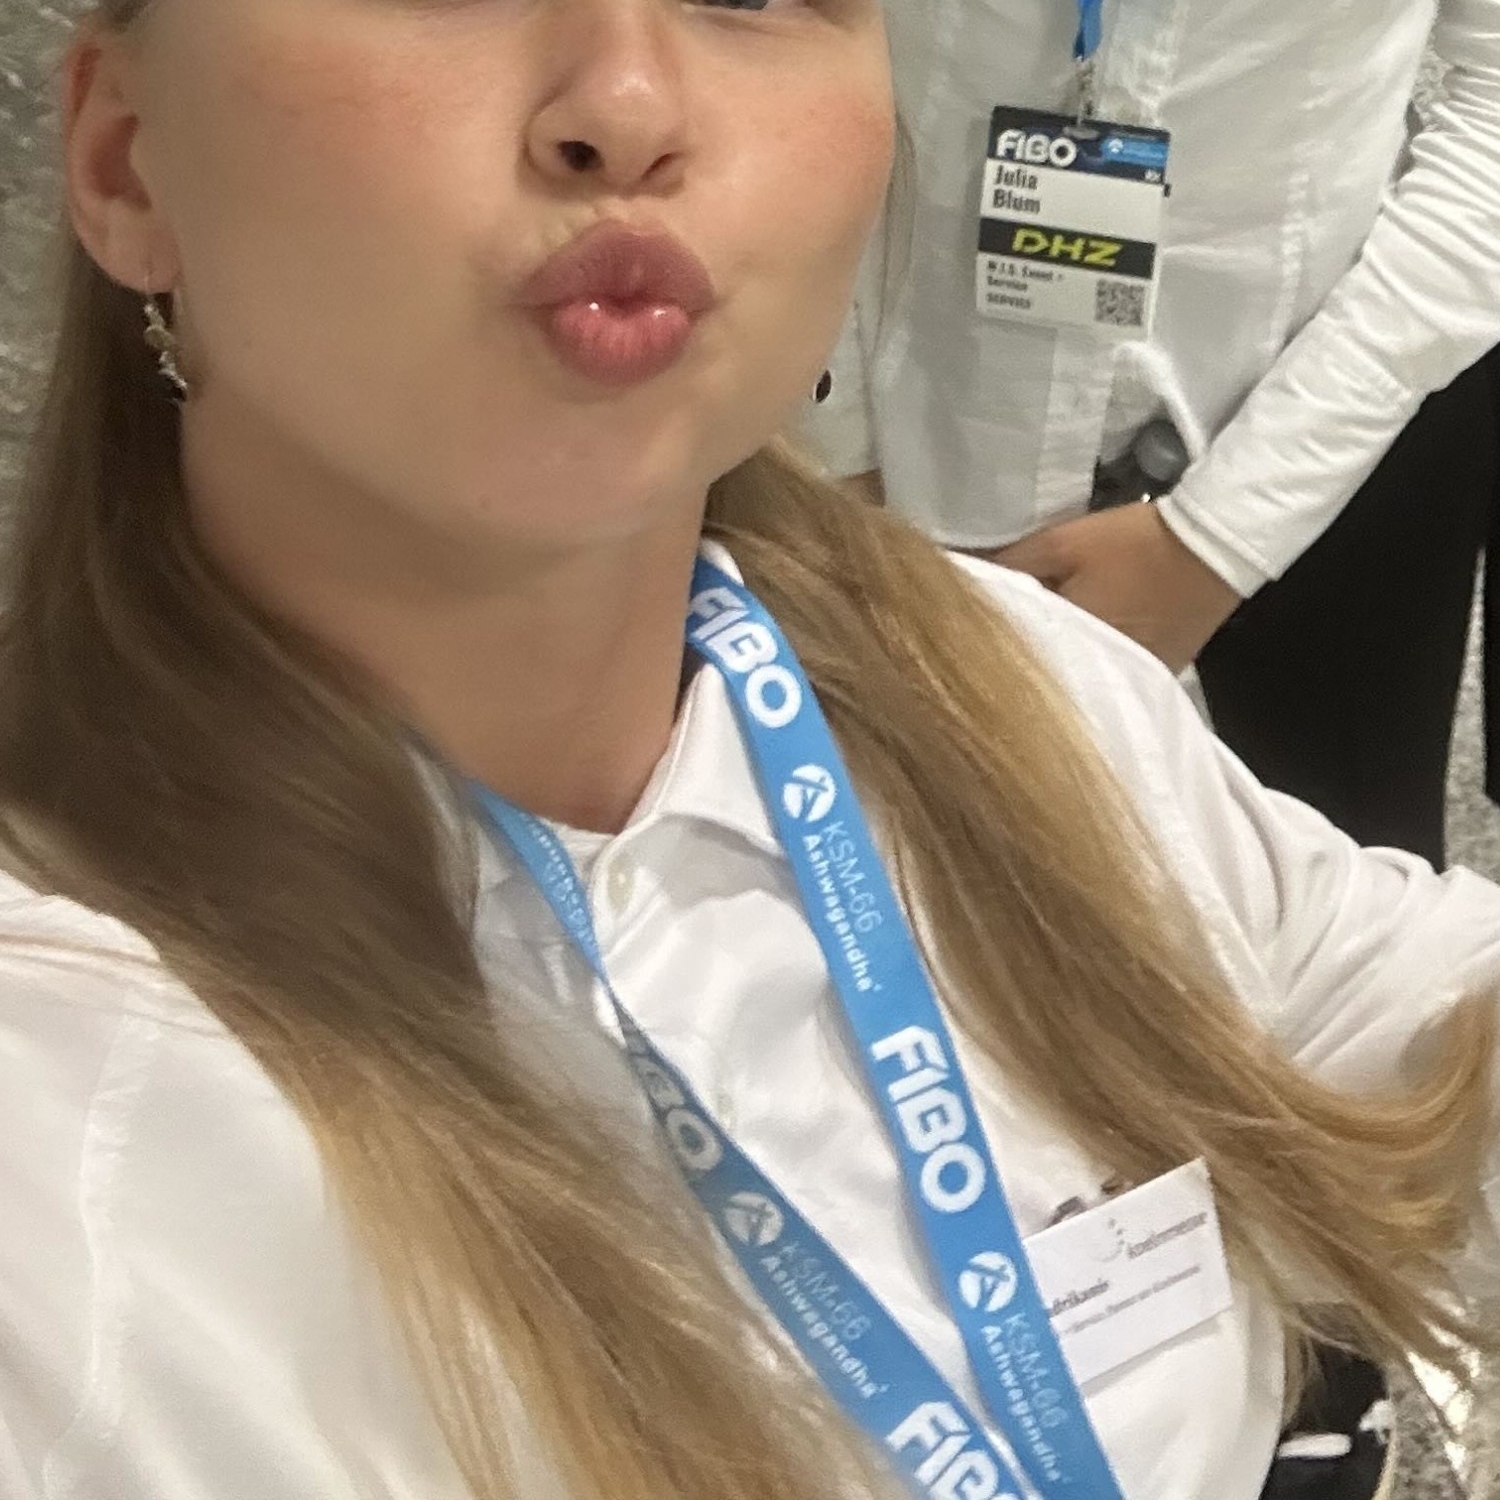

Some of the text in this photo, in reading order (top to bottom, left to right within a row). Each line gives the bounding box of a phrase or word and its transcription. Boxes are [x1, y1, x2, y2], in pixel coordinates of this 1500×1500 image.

[995, 165, 1039, 191] Julia
[997, 128, 1078, 168] FIBO
[992, 188, 1041, 214] Blum
[1011, 228, 1125, 268] DHZ
[689, 586, 801, 728] FIBO
[821, 820, 884, 933] KSM-66
[871, 1025, 986, 1214] FIBO
[778, 1241, 872, 1341] KSM-66
[884, 1401, 1021, 1500] FIB
